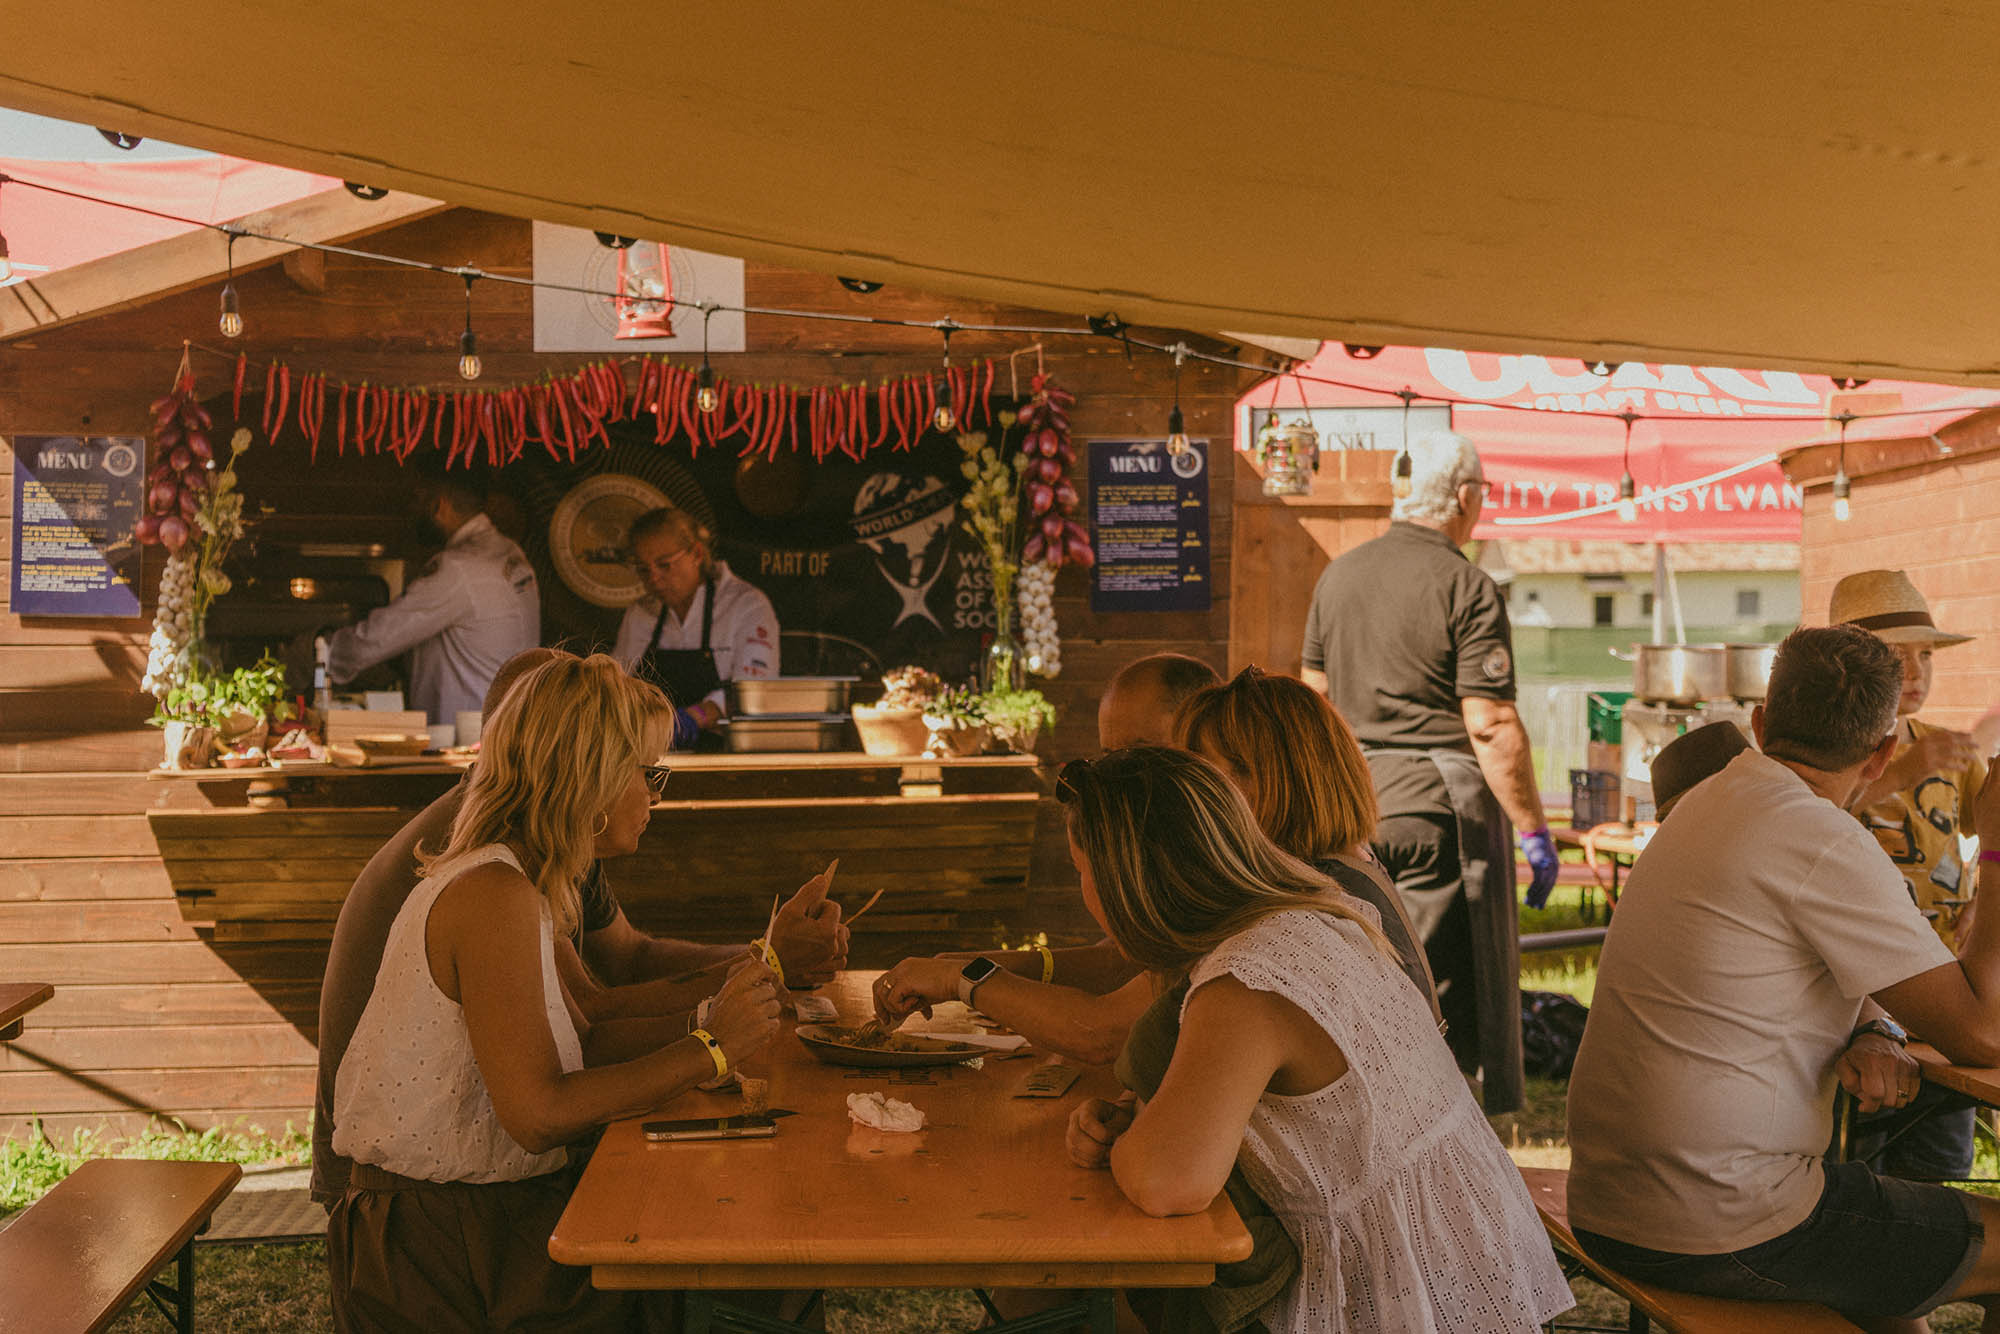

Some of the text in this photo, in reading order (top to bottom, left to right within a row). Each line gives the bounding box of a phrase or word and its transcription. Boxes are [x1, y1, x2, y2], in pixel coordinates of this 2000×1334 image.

[37, 451, 92, 470] MENU
[1109, 456, 1162, 473] MENU
[1571, 481, 1803, 512] TRNSYLVAN
[855, 508, 914, 536] WORLD
[761, 551, 830, 577] PART OF
